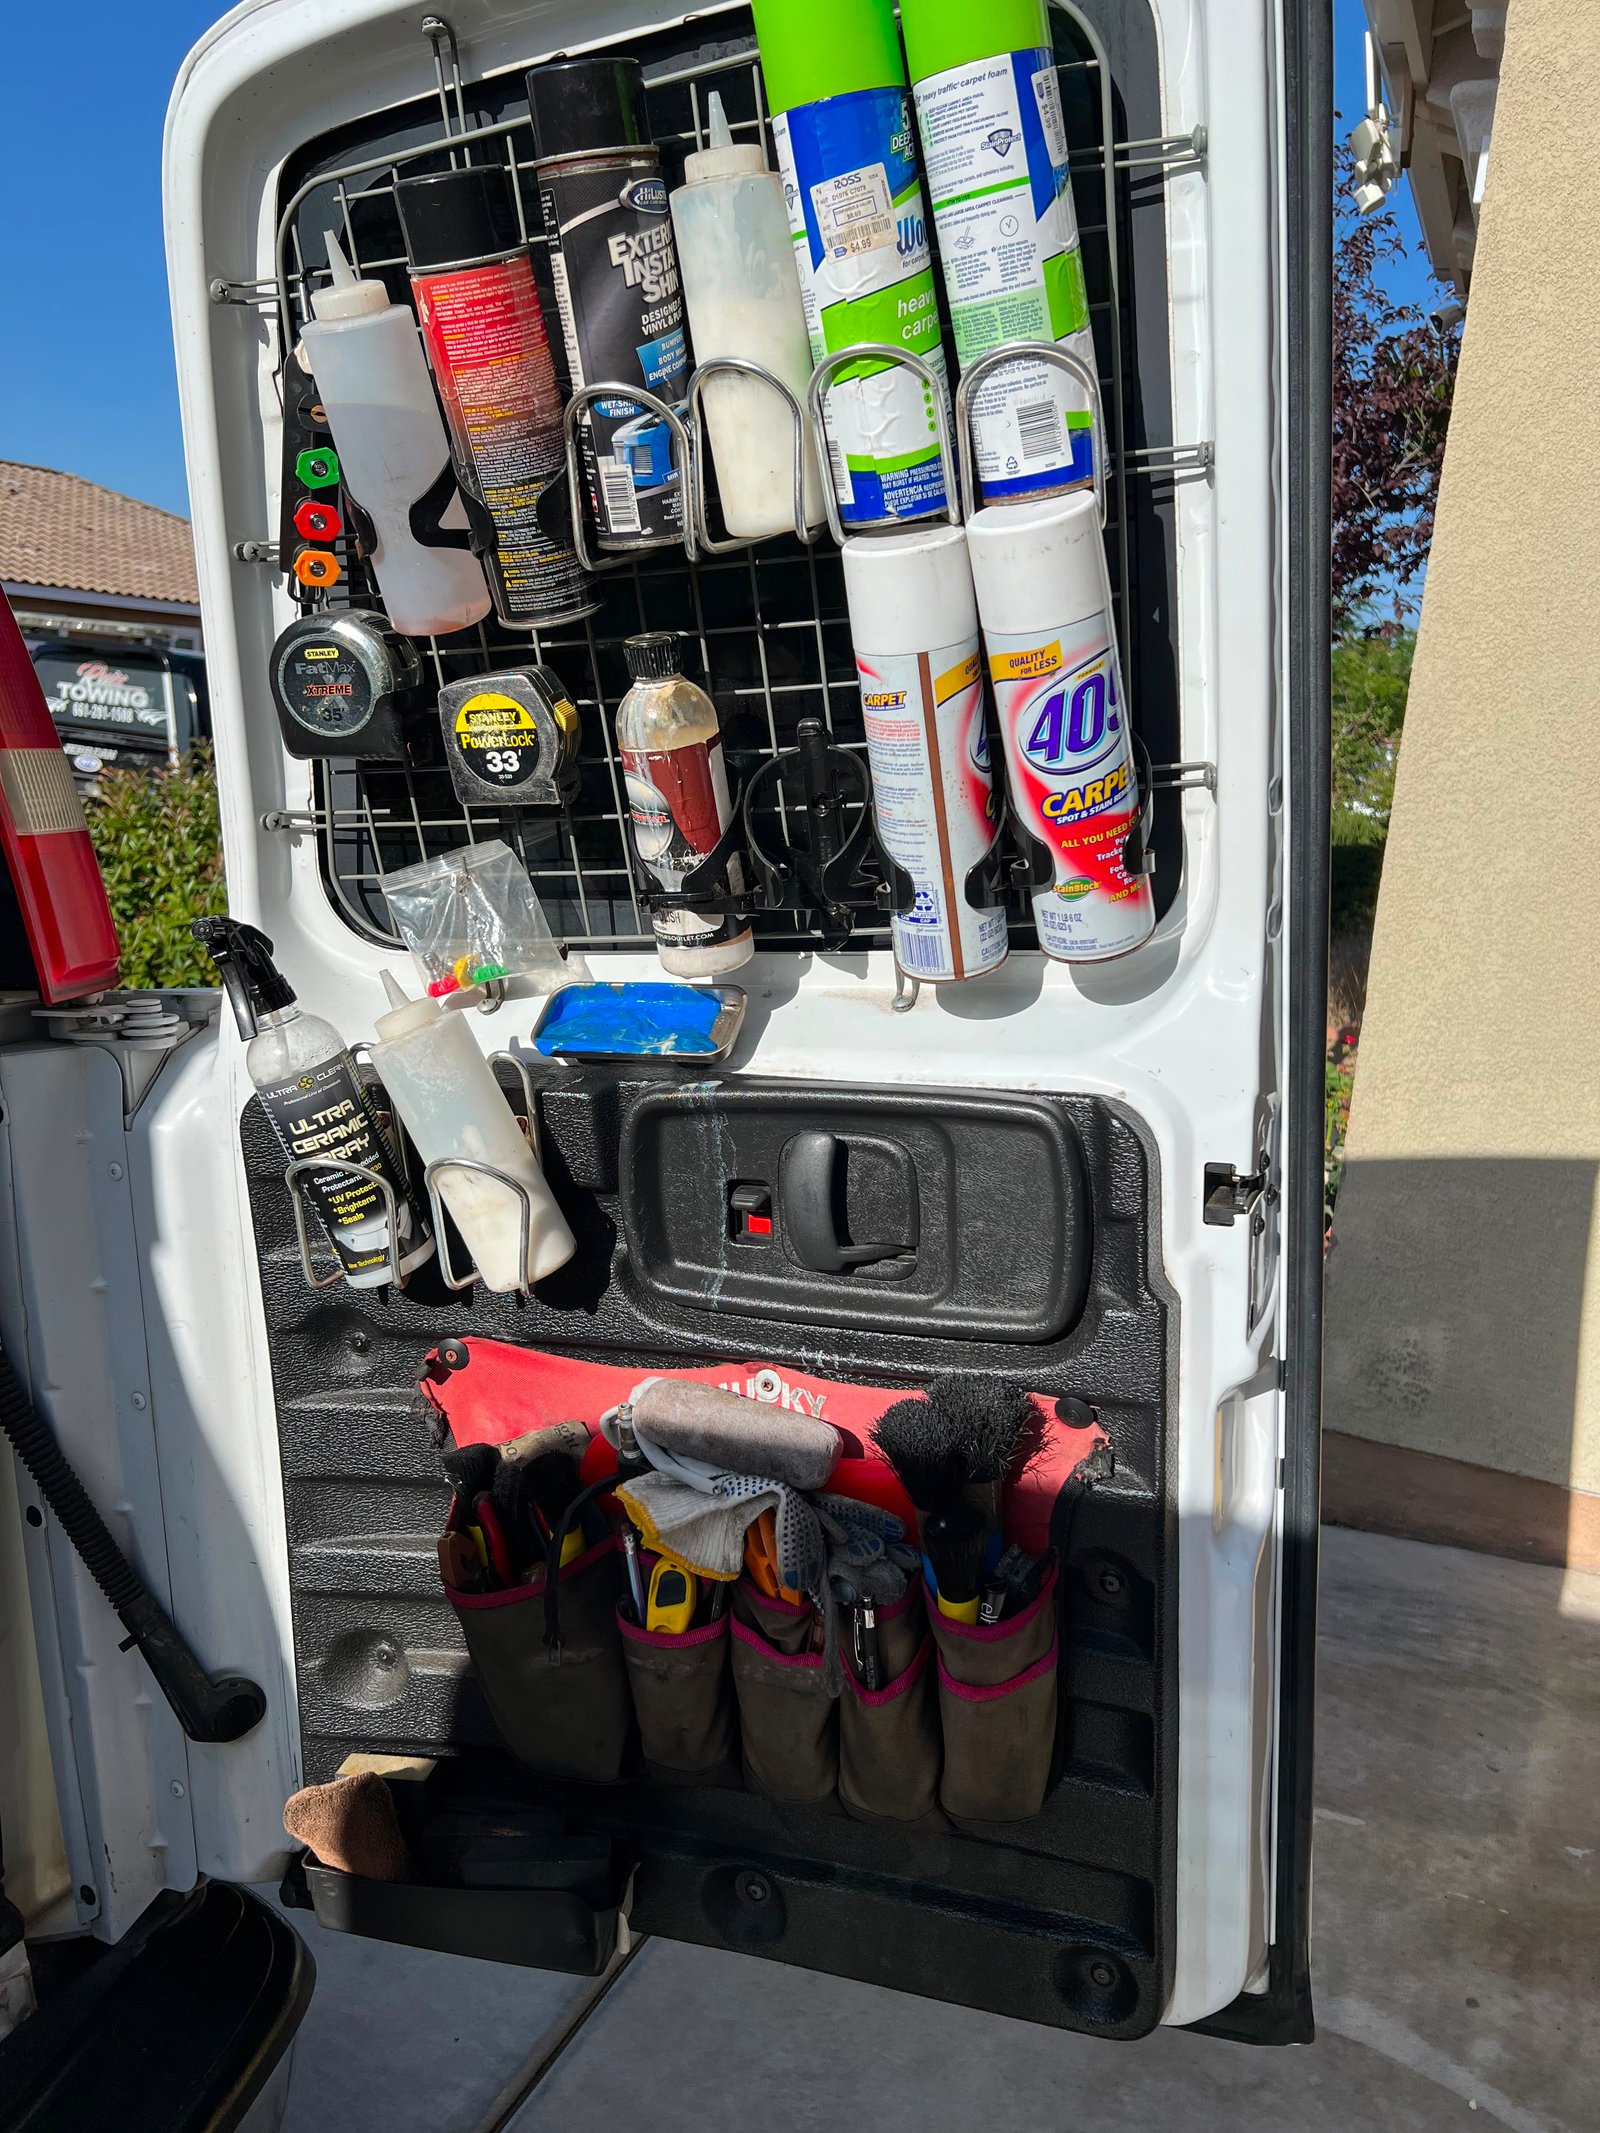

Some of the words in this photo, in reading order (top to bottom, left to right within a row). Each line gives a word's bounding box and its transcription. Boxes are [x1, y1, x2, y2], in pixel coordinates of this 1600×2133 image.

[960, 73, 986, 88] carpet
[988, 68, 1007, 80] foam
[981, 133, 1022, 151] StainProtect
[833, 173, 862, 190] ROSS
[975, 201, 991, 210] CARPET
[850, 238, 872, 252] $4.99
[902, 260, 911, 268] for
[897, 287, 936, 318] heavy
[642, 318, 668, 336] VINYL
[668, 315, 674, 326] &
[658, 351, 675, 365] BODY
[649, 364, 672, 381] ENGINE
[601, 400, 642, 409] WET-SHINE
[610, 407, 634, 416] FINISH
[880, 469, 909, 482] WARNING
[882, 481, 892, 489] MAY
[892, 478, 908, 488] BURST
[884, 484, 923, 500] ADVERTENCIA
[294, 660, 356, 674] FatMax
[1009, 650, 1045, 668] QUALITY
[1020, 667, 1032, 676] FOR
[1034, 656, 1057, 671] LESS
[57, 681, 150, 708] TOWING
[306, 685, 351, 695] XTREME
[863, 691, 906, 707] CARPET
[322, 708, 345, 721] 35'
[469, 712, 516, 724] STANLEY
[461, 730, 534, 749] PowerLock
[486, 749, 522, 772] 33'
[1057, 812, 1079, 824] SPOT
[1080, 810, 1088, 818] &
[1089, 798, 1113, 815] STAIN
[1061, 838, 1080, 849] ALL
[1082, 833, 1104, 846] YOU
[1105, 823, 1128, 839] NEED
[1096, 847, 1123, 861] Tracke
[1110, 864, 1124, 874] Foo
[1108, 888, 1129, 903] AND
[1050, 911, 1057, 919] WT
[1061, 913, 1068, 922] LB
[1074, 913, 1082, 921] OZ
[1045, 933, 1068, 944] CAUTION:
[266, 1085, 298, 1099] ULTRA
[316, 1063, 344, 1081] CLEAN
[284, 1094, 308, 1106] Professional
[289, 1099, 355, 1135] ULTRA
[292, 1112, 369, 1154] CERAMIC
[310, 1132, 370, 1160] PRAY
[313, 1170, 344, 1185] Ceramic
[321, 1175, 362, 1193] Protectant
[346, 1181, 379, 1199] Protect
[358, 1254, 385, 1267] Technology
